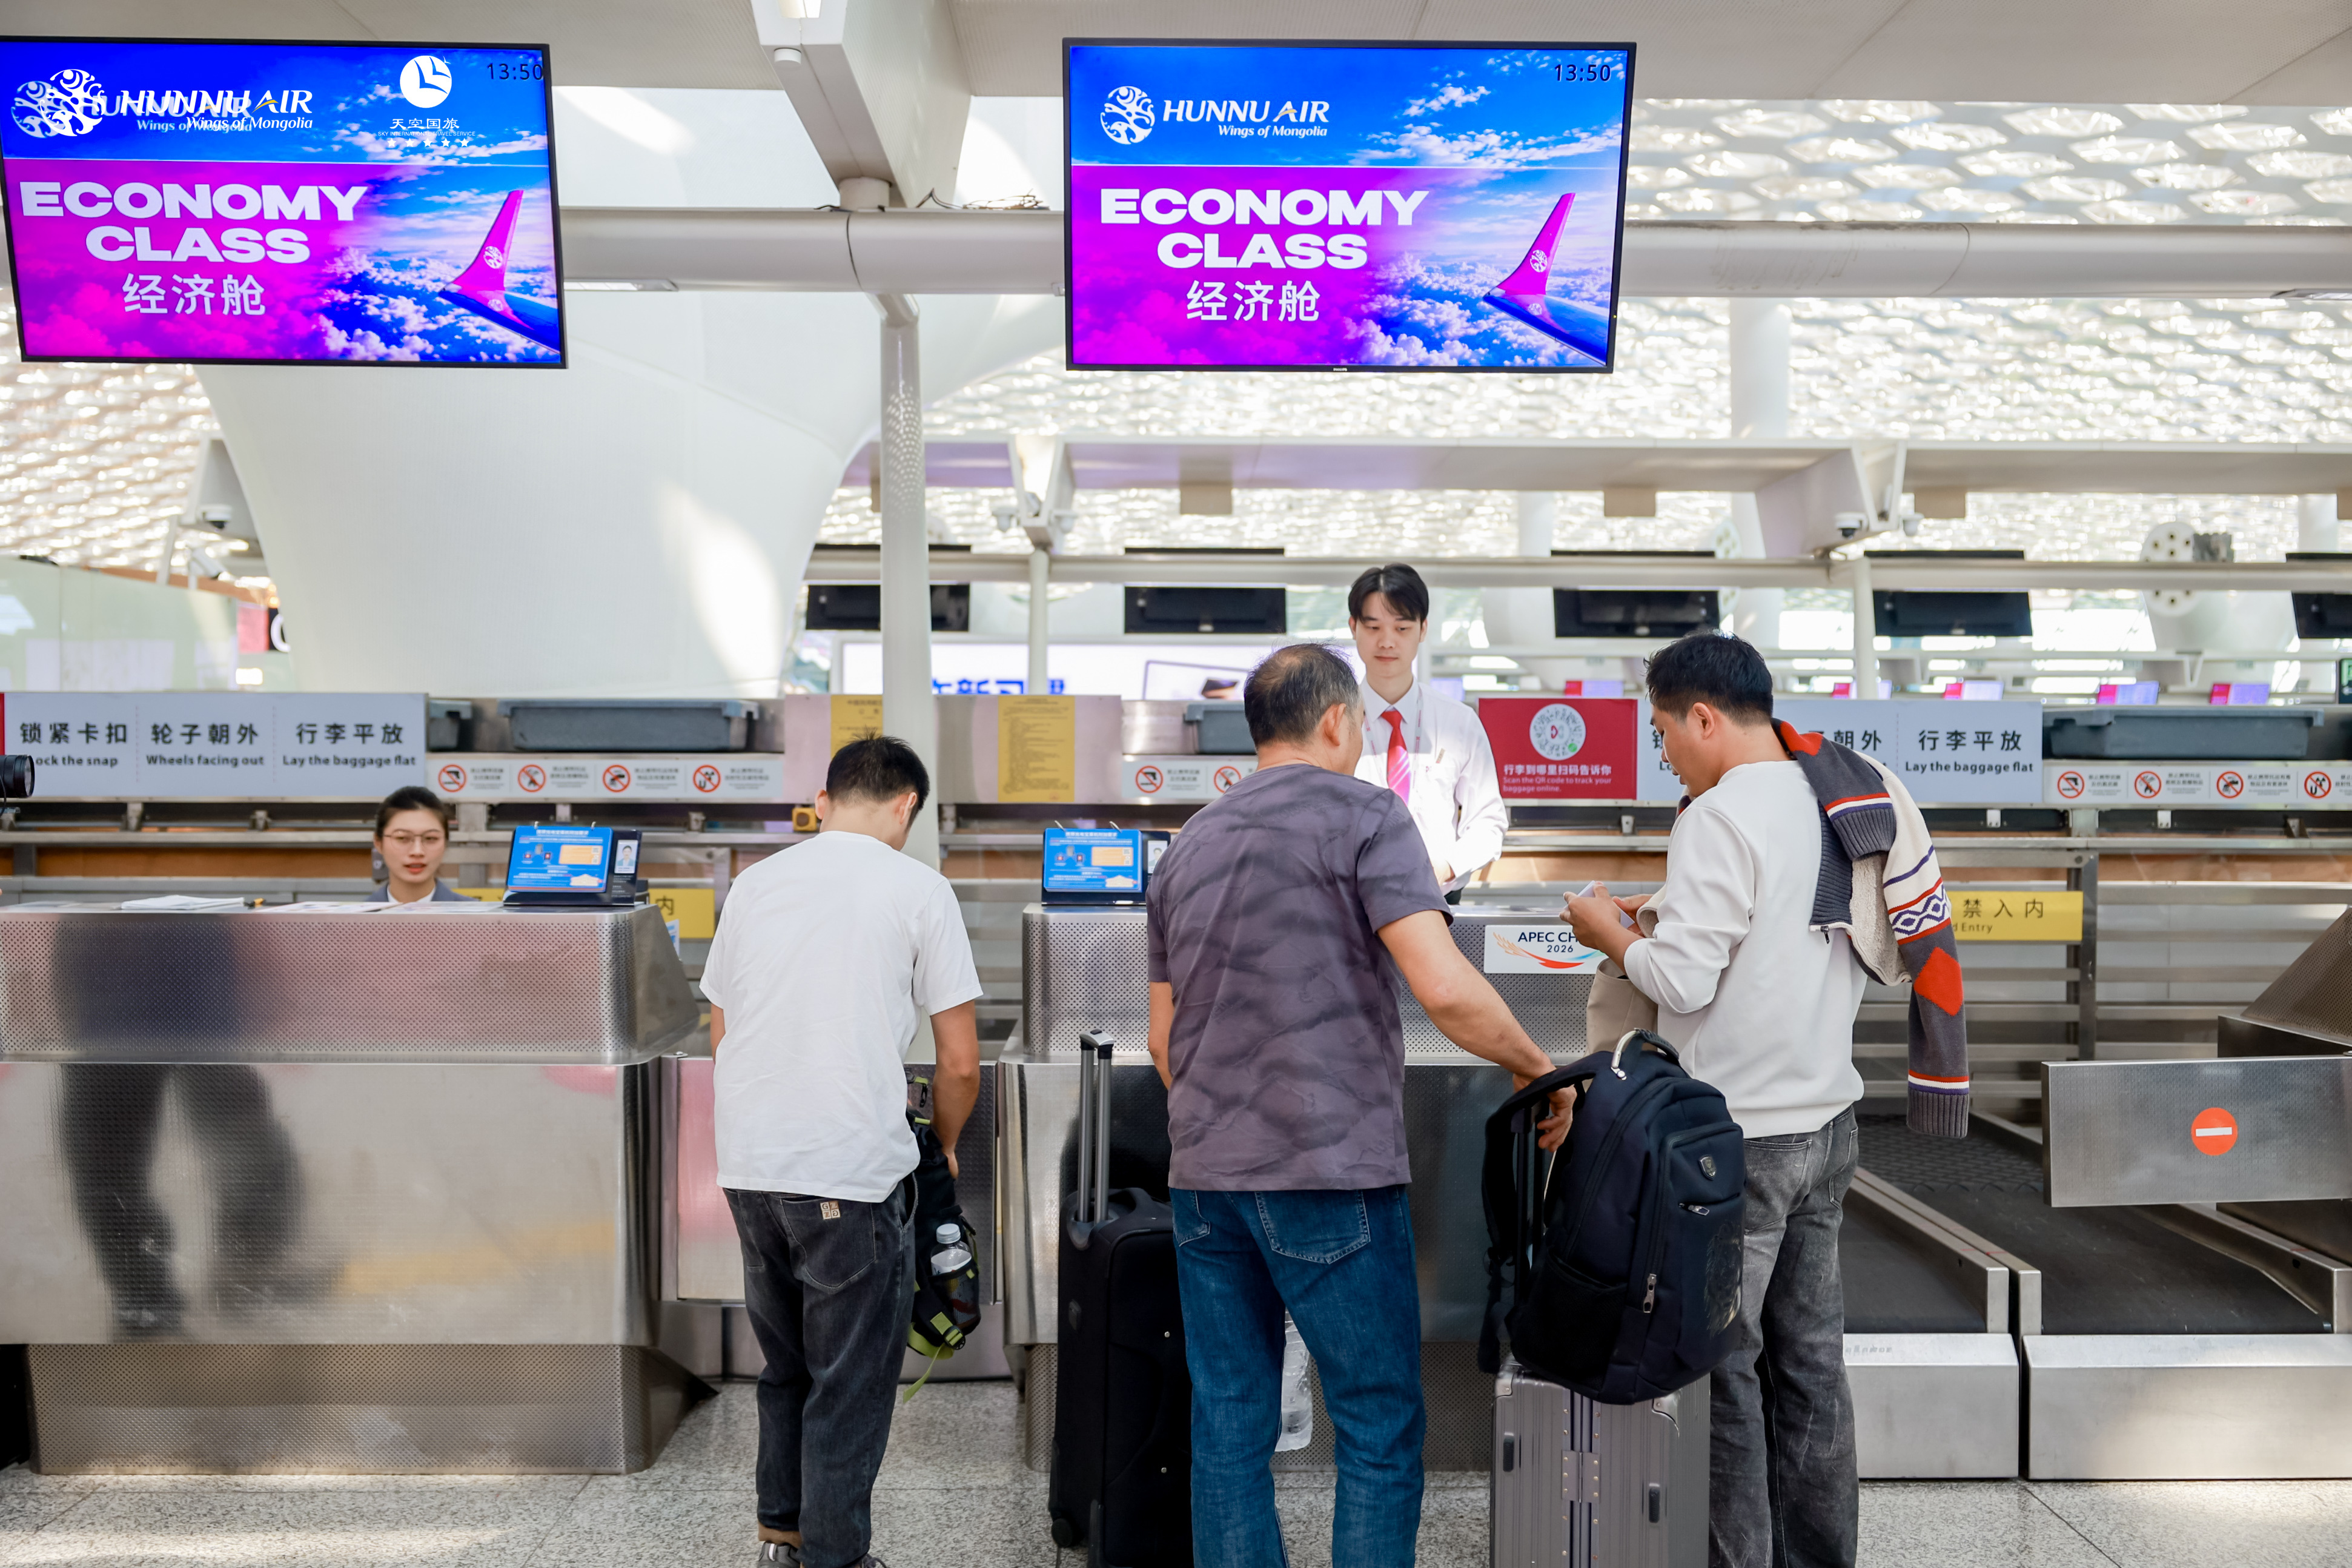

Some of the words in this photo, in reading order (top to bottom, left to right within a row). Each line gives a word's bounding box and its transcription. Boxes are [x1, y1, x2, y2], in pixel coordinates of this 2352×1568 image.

[487, 63, 543, 80] 13:50
[1554, 64, 1611, 82] 13:50
[1162, 99, 1270, 122] HUNNU
[1273, 101, 1330, 122] AIR
[137, 119, 175, 133] Wings
[1218, 125, 1254, 138] Wings
[1257, 125, 1271, 138] of
[1273, 125, 1328, 139] Mongolia
[20, 181, 367, 221] ECONOMY
[1100, 188, 1429, 226] ECONOMY
[85, 225, 311, 263] CLASS
[1157, 233, 1368, 270] CLASS
[123, 273, 266, 316] 经济舱
[1187, 280, 1320, 323] 经济舱
[20, 722, 127, 744] 锁紧卡扣
[151, 723, 258, 745] 轮子朝外
[296, 723, 403, 744] 行李平放
[1918, 730, 2022, 751] 行李平放
[36, 755, 58, 766] ock
[62, 755, 83, 766] the
[87, 757, 119, 769] snap
[146, 755, 194, 766] Wheels
[197, 755, 238, 768] facing
[242, 756, 265, 766] out
[283, 755, 304, 768] Lay
[308, 755, 330, 766] the
[333, 755, 391, 768] baggage
[394, 755, 416, 766] flat
[1906, 761, 1927, 774] Lay
[1930, 761, 1950, 772] the
[1954, 761, 2010, 775] baggage
[2013, 761, 2033, 772] flat
[1963, 898, 2044, 919] 禁入内
[1518, 932, 1555, 942] APEC
[1558, 932, 1578, 942] CH
[1962, 922, 1993, 935] Entry
